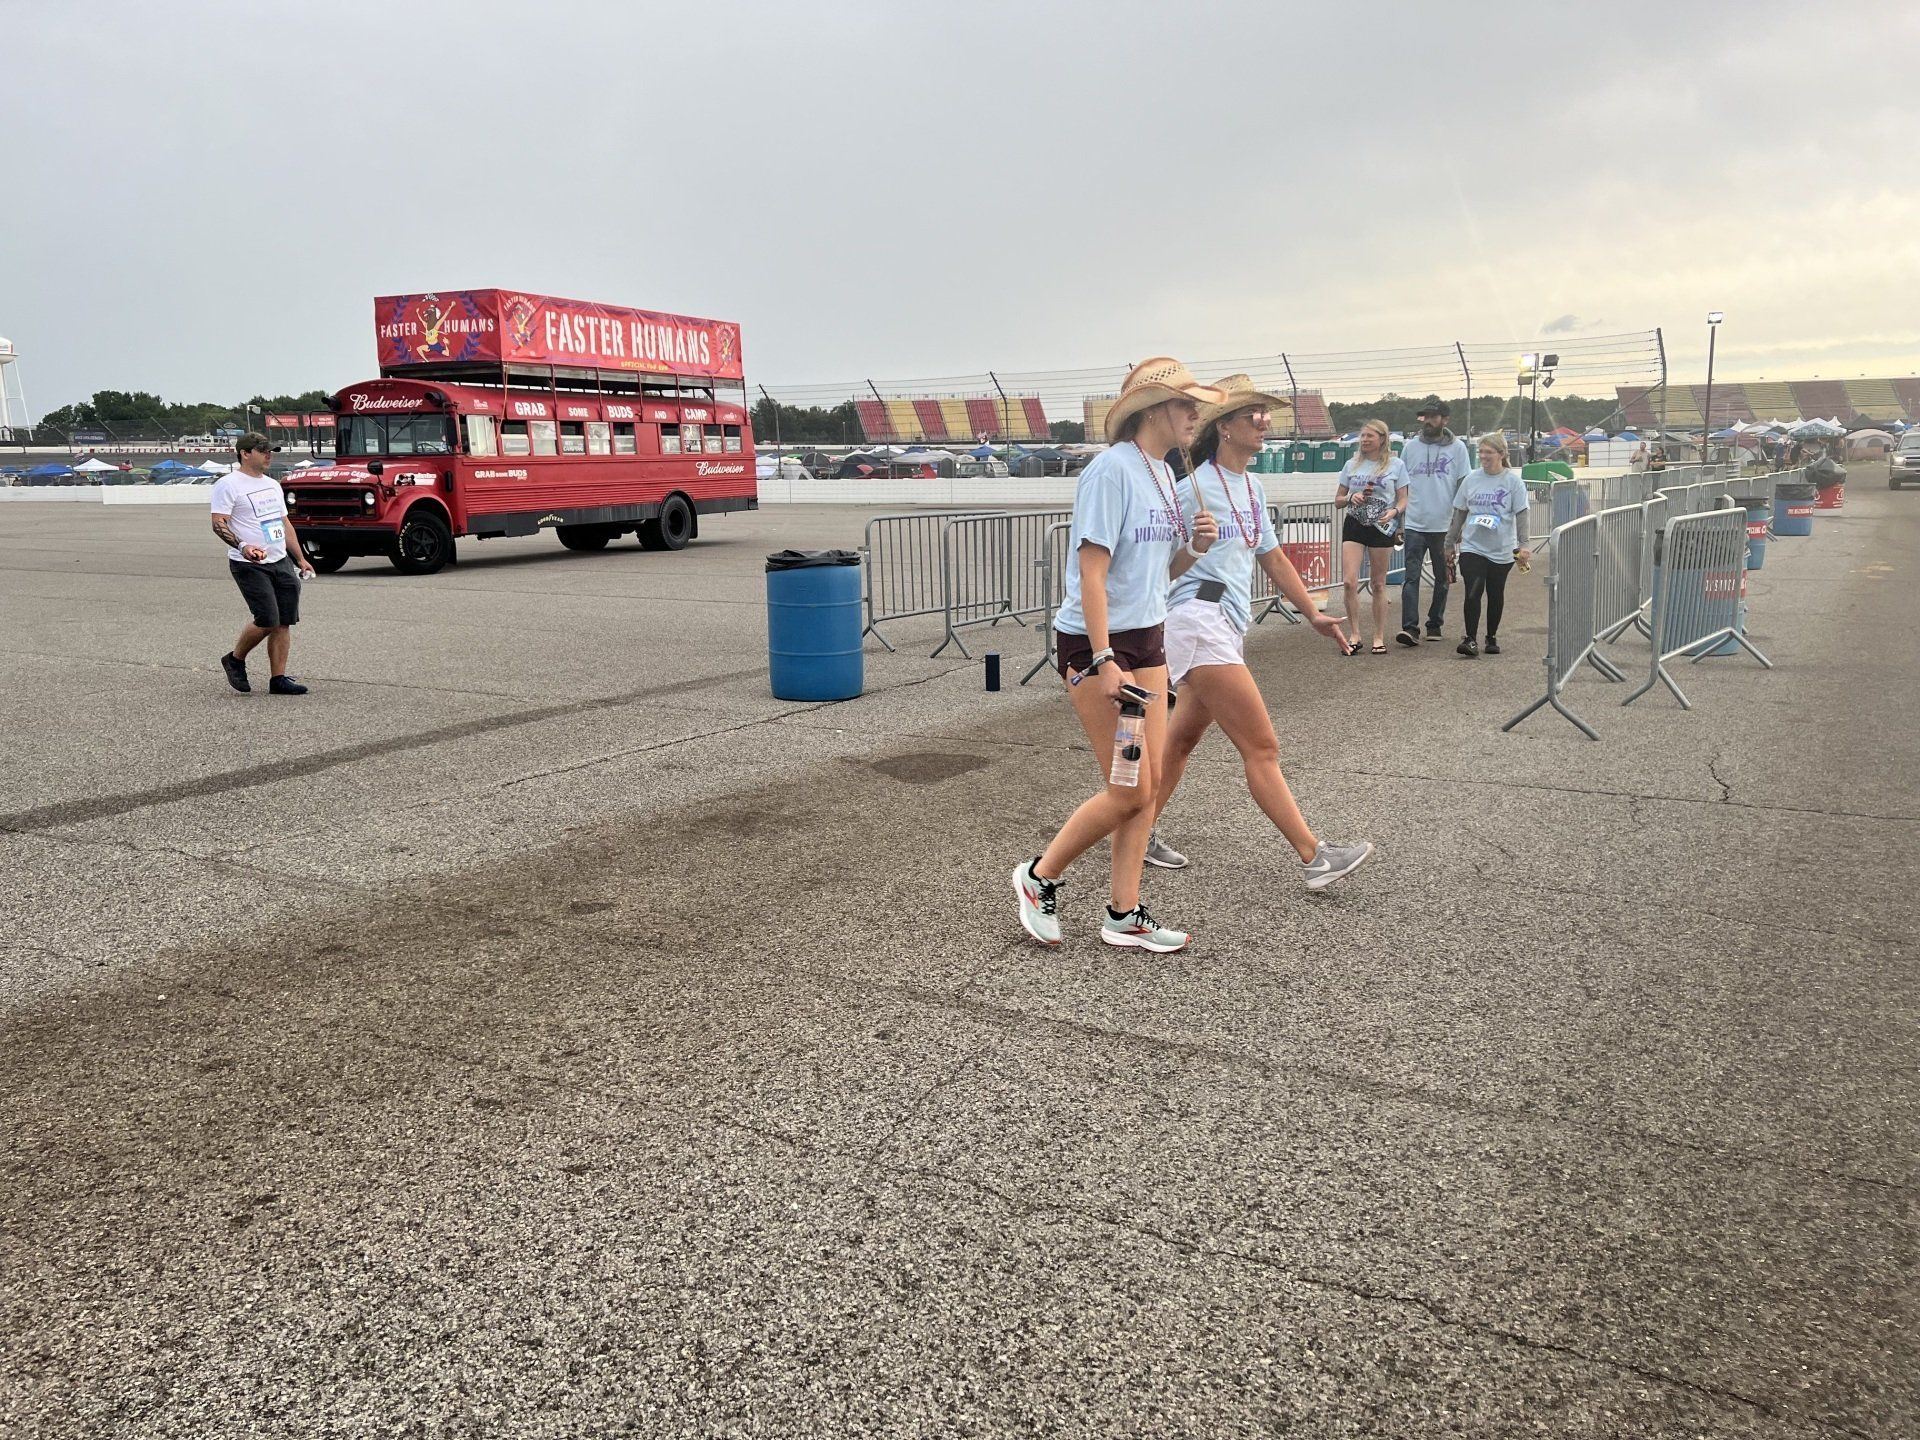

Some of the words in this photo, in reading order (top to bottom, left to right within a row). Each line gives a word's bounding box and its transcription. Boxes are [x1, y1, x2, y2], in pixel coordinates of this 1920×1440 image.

[380, 322, 418, 339] FASTER
[444, 318, 495, 334] HUMANS
[545, 310, 625, 358] FASTER
[630, 322, 711, 365] HUMANS
[350, 393, 423, 411] Budweiser
[514, 402, 547, 416] GRAB
[568, 407, 589, 417] SOME
[607, 405, 634, 418] BUDS
[654, 411, 667, 419] AND
[684, 408, 707, 420] CAMP
[287, 471, 306, 481] GRAB
[350, 470, 371, 479] CAMP
[474, 470, 495, 479] GRAB
[508, 470, 527, 478] BUDS
[695, 461, 744, 476] Budweiser
[1150, 509, 1173, 525] FASTE
[1477, 517, 1492, 525] 247
[273, 528, 283, 539] 29
